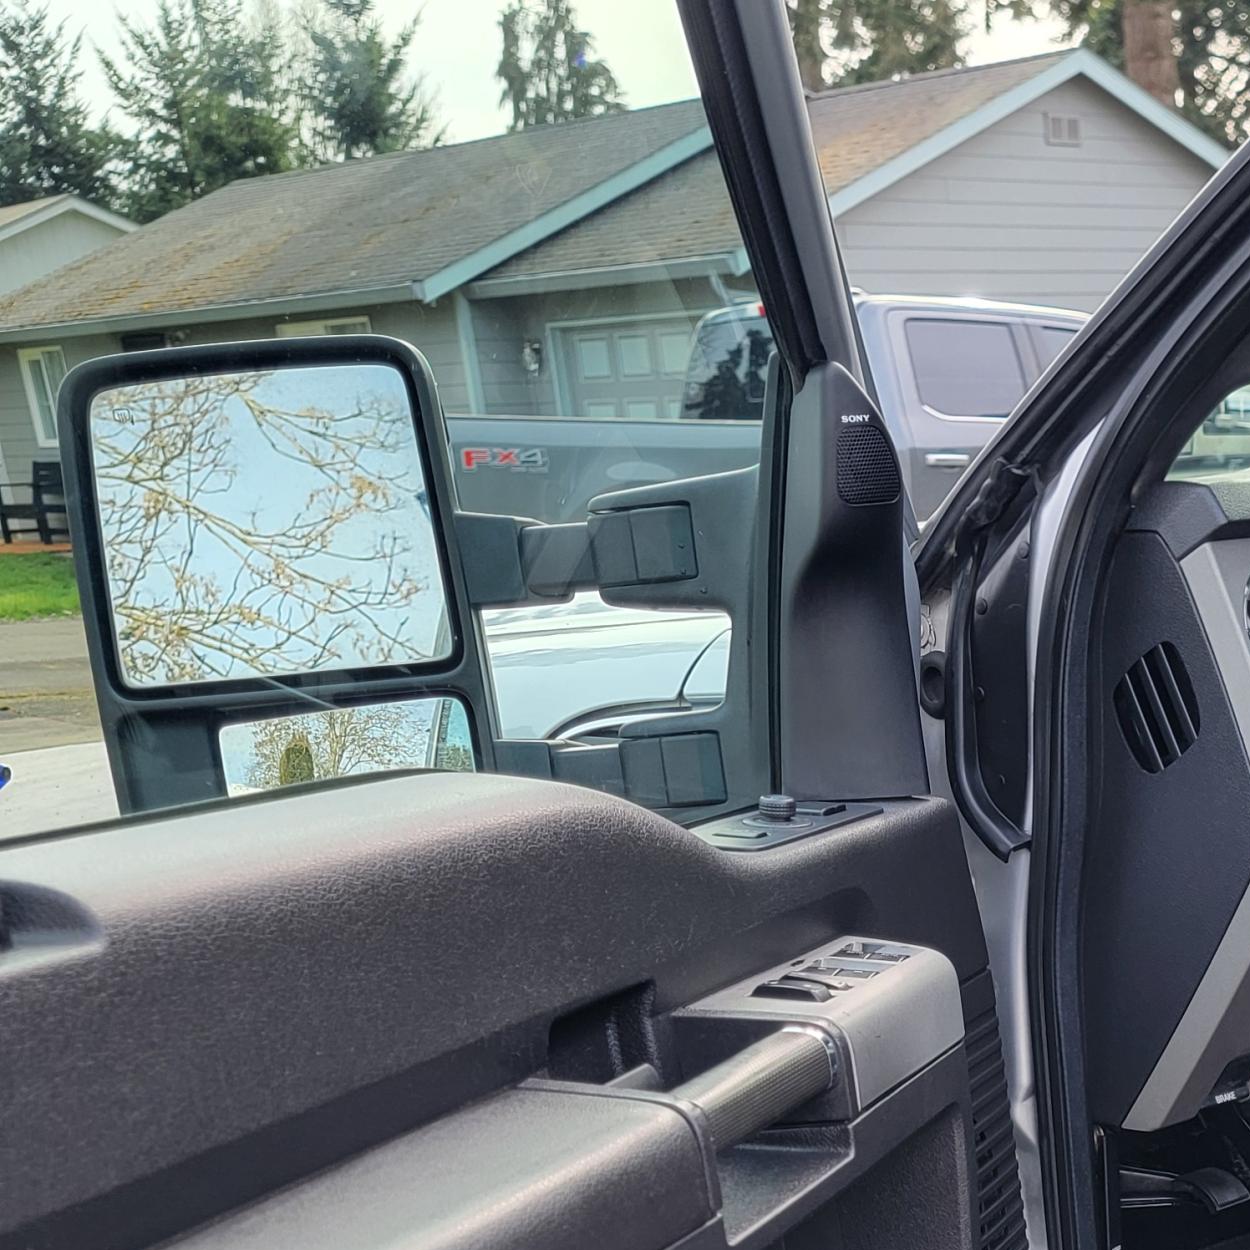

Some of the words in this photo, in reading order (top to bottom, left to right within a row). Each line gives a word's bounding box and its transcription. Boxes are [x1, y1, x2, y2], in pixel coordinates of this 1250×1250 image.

[841, 414, 870, 423] SONY
[462, 448, 546, 471] FX4
[1215, 1091, 1237, 1104] BRAKE
